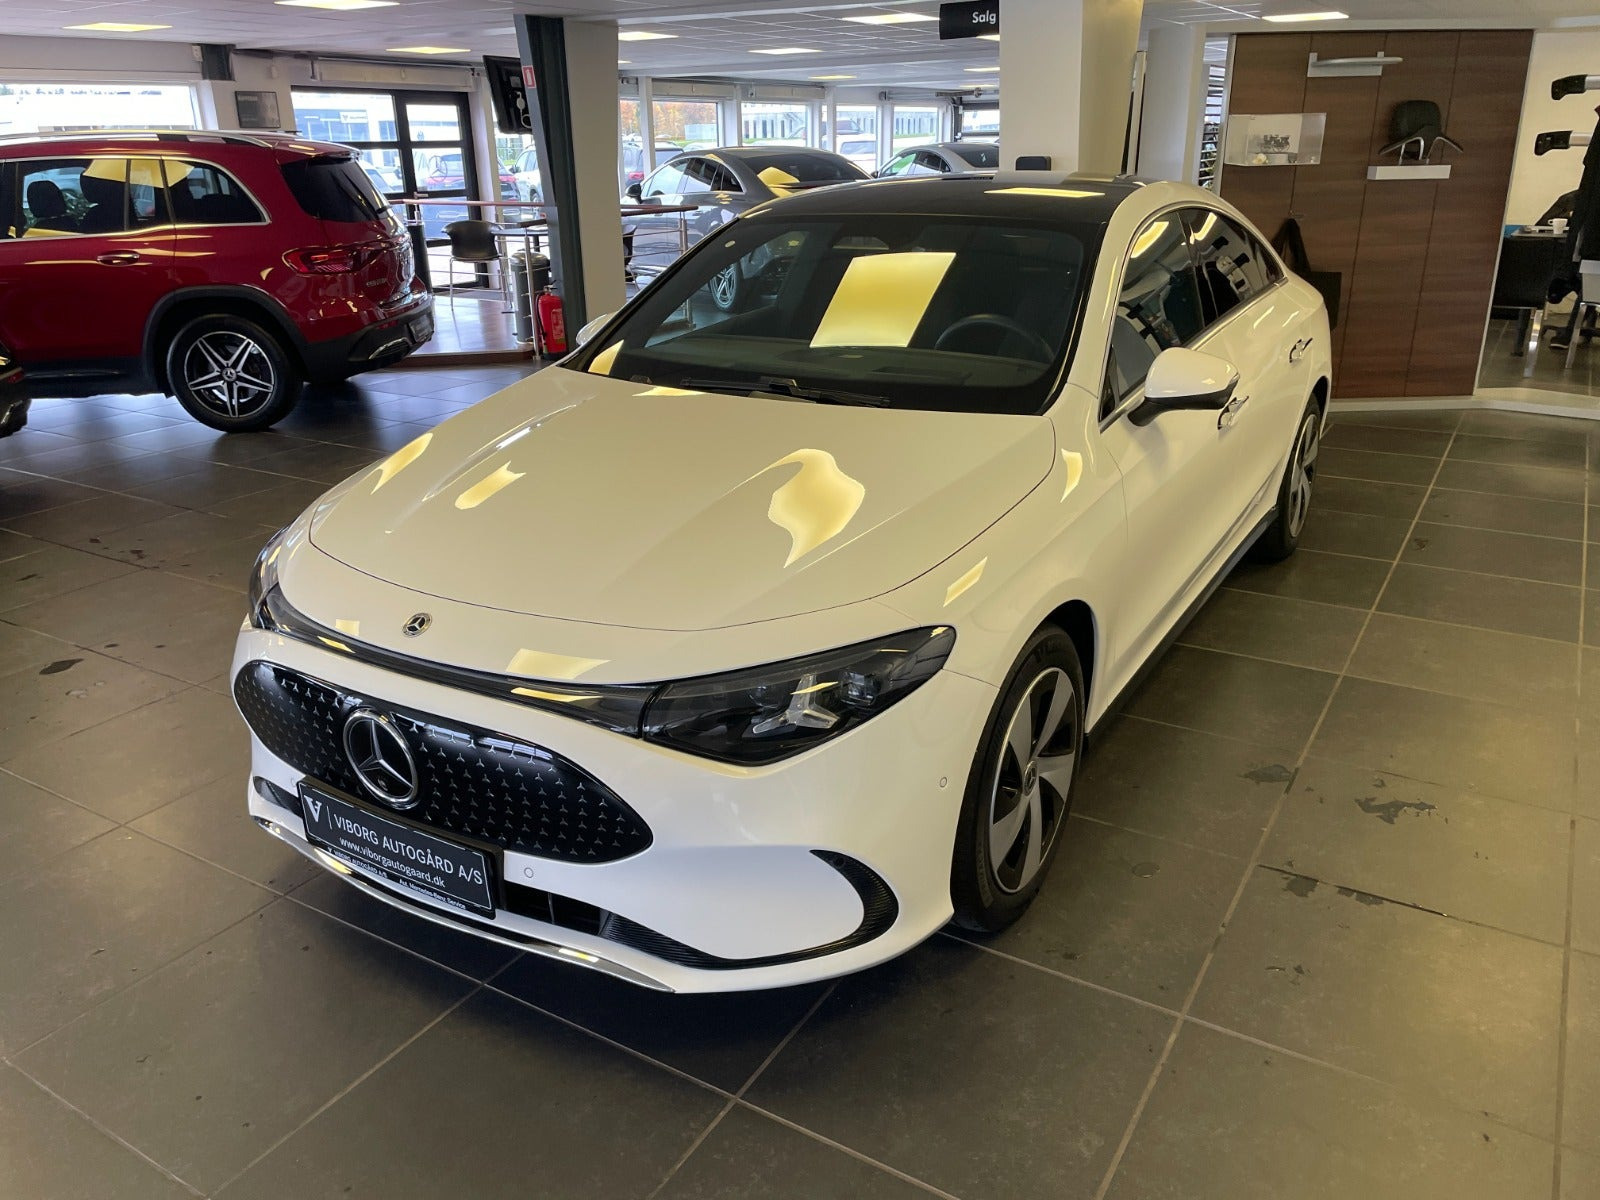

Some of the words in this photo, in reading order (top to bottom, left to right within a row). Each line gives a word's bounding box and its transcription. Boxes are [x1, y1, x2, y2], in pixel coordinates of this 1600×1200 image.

[972, 10, 997, 25] Salg
[333, 813, 379, 845] VIBORG
[382, 835, 454, 874] AUTOGÅRD
[458, 864, 483, 885] A/S
[339, 836, 446, 888] www.viborgautogaard.dk
